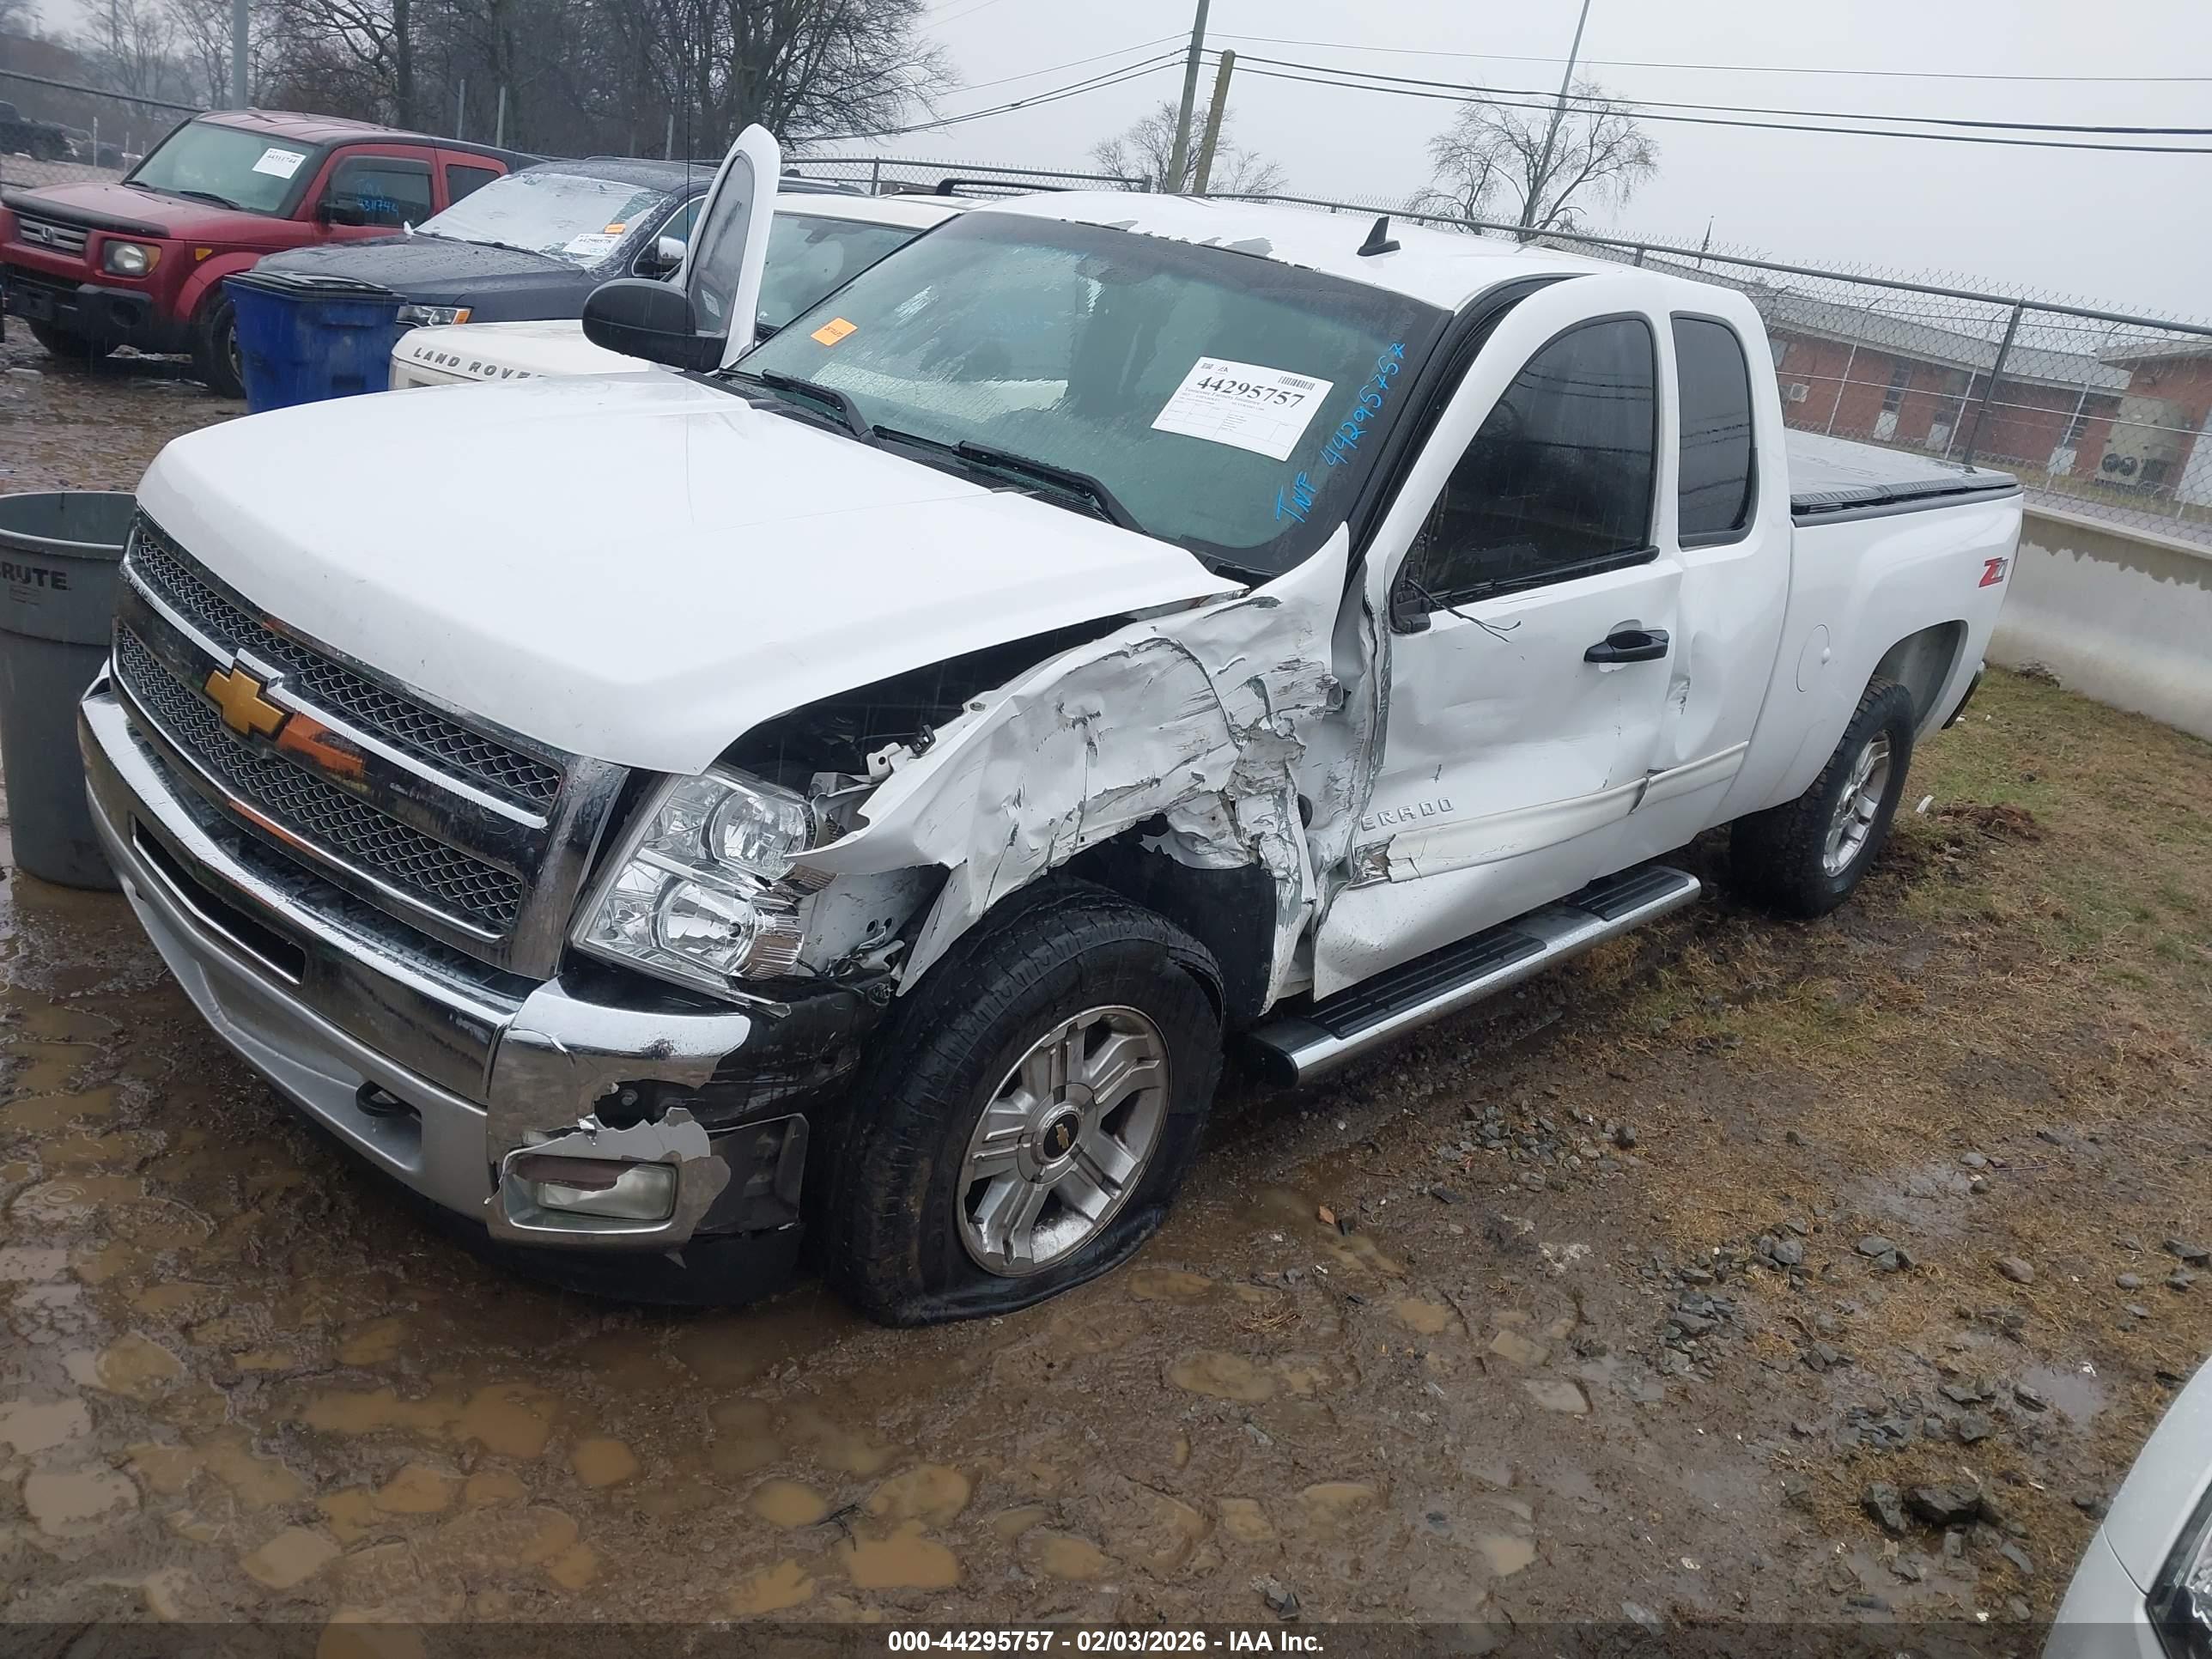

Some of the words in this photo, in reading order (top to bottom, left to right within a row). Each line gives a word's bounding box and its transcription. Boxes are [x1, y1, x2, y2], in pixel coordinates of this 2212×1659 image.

[413, 347, 461, 368] LAND
[468, 361, 550, 380] ROVE
[1197, 375, 1306, 409] 44295757
[1275, 471, 1316, 523] TNF
[1320, 343, 1407, 466] 44295757
[0, 561, 68, 591] RUTE
